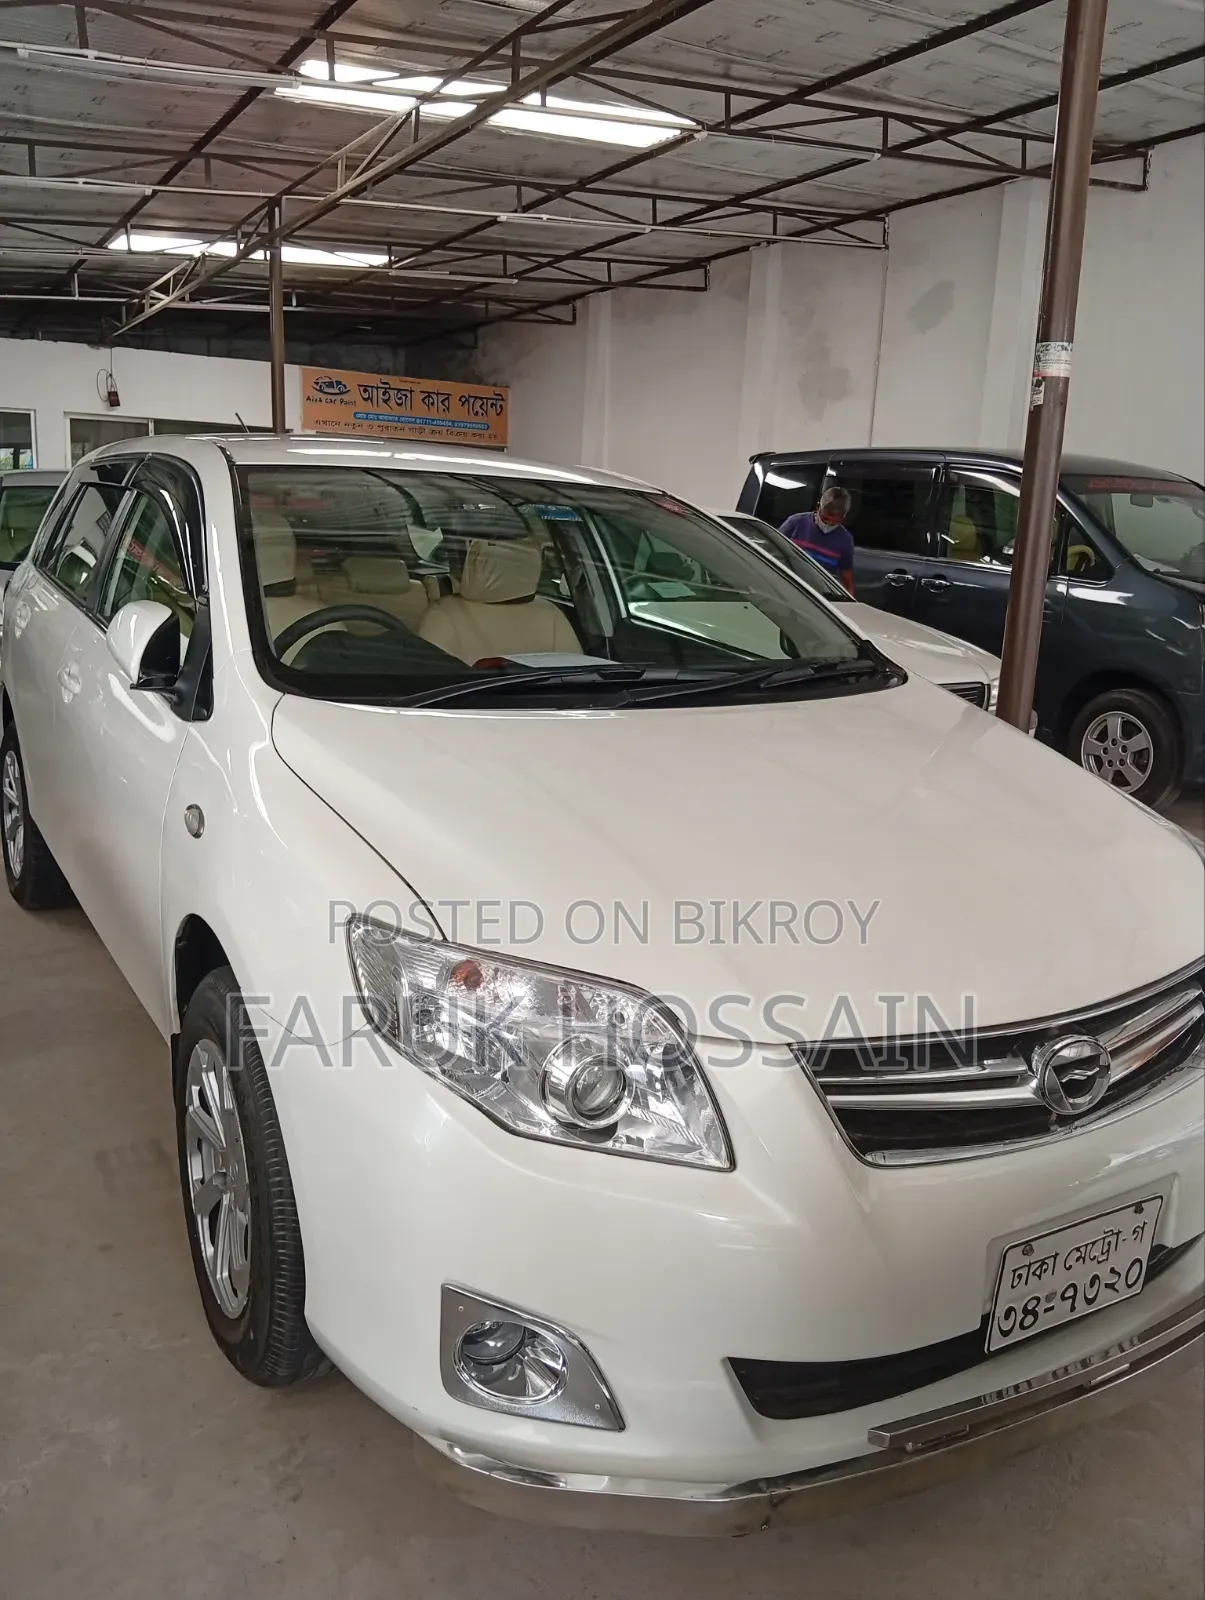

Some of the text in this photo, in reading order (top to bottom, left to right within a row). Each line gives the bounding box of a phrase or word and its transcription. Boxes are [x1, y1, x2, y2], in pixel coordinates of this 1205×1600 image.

[340, 398, 356, 407] Point
[357, 378, 506, 417] আইজা কার পয়েন্ট
[1010, 1250, 1060, 1290] ঢাকা
[997, 1257, 1144, 1338] ৩৪-৭৩২০
